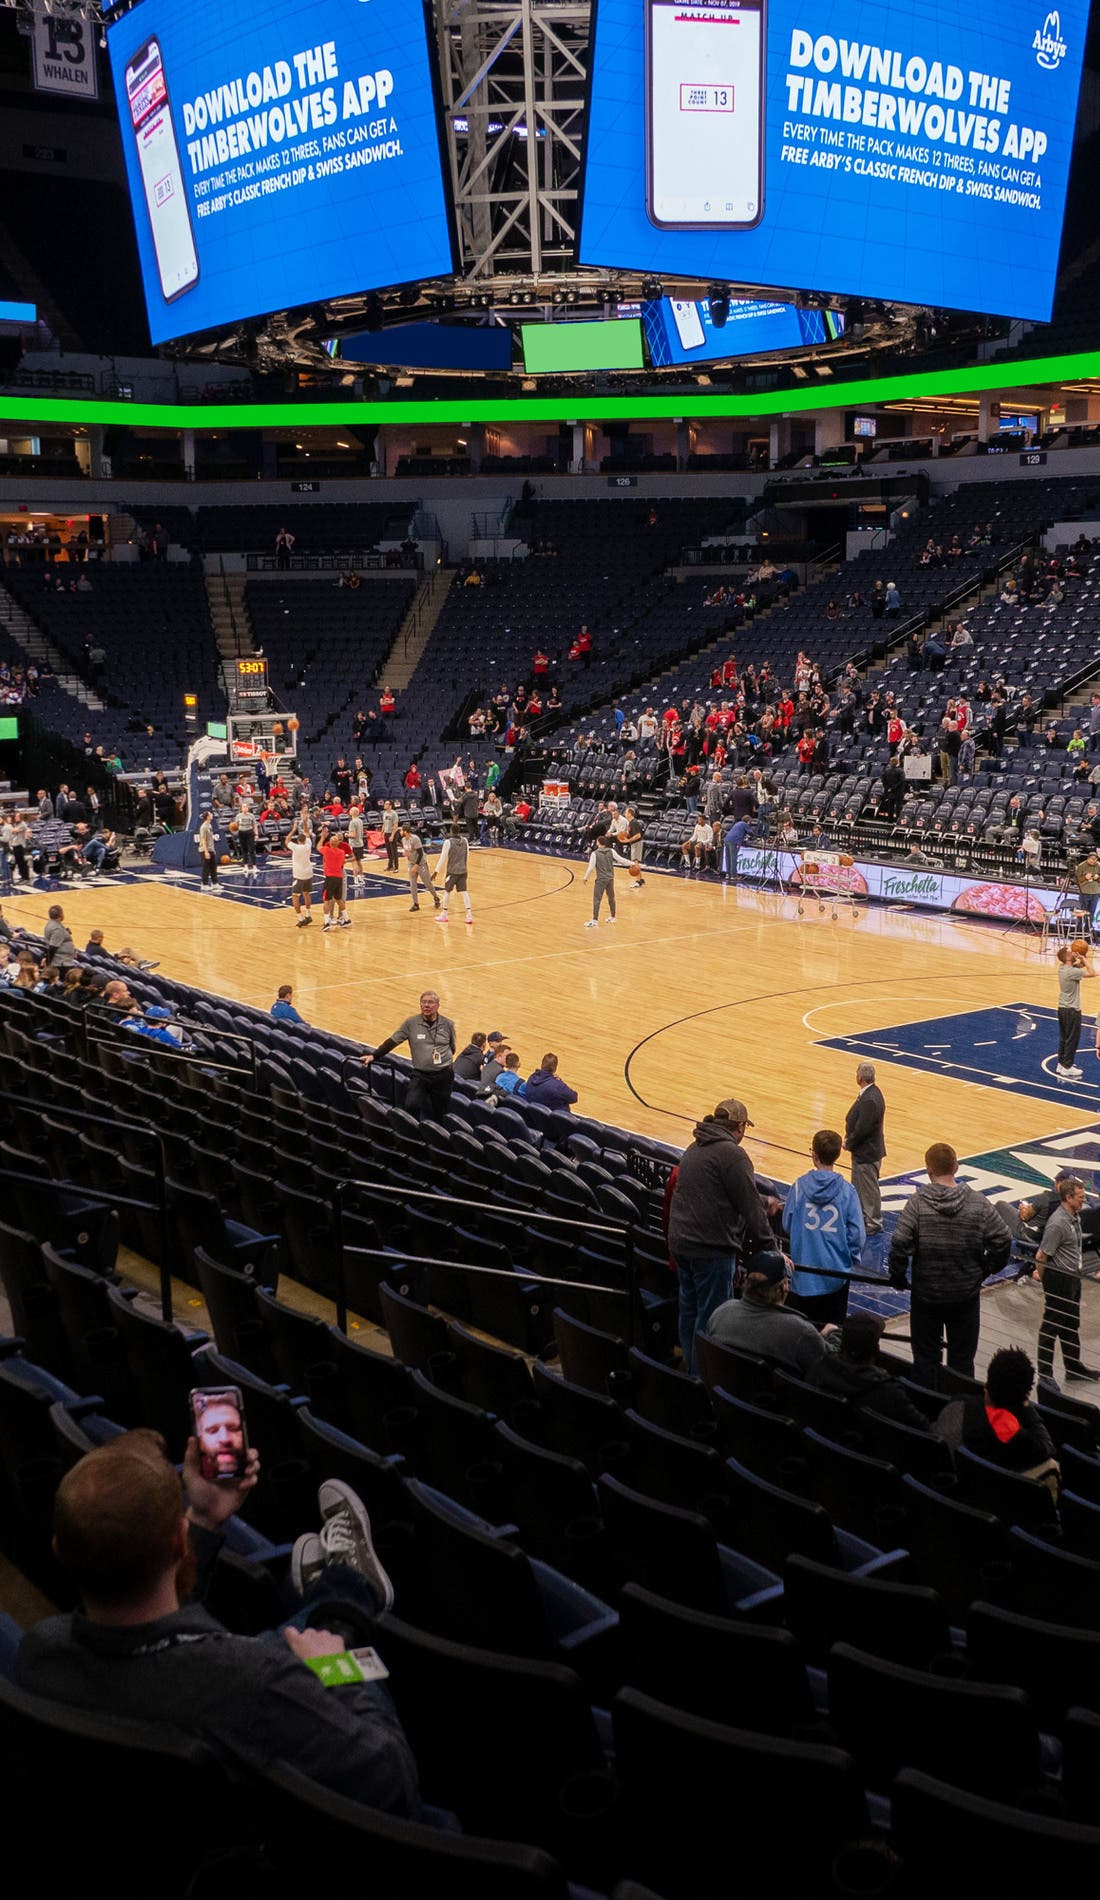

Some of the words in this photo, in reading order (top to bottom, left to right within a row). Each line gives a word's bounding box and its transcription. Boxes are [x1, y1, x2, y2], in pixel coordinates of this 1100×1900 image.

[1032, 30, 1067, 60] Arby's
[43, 63, 89, 84] WHALEN
[182, 60, 292, 136] DOWNLOAD
[292, 40, 339, 90] THE
[789, 28, 964, 102] DOWNLOAD
[968, 70, 1012, 115] THE
[187, 87, 338, 174] TIMBERWOLVES
[342, 69, 394, 120] APP
[714, 91, 728, 106] 13
[785, 73, 1001, 154] TIMBERWOLVES
[1002, 124, 1048, 164] APP
[193, 177, 212, 198] EVERY
[212, 173, 225, 192] TIME
[224, 169, 237, 186] THE
[237, 162, 255, 182] PACK
[255, 152, 280, 175] MAKES
[281, 149, 290, 166] 12
[291, 140, 321, 163] THREES,
[322, 131, 346, 153] FANS
[346, 123, 368, 146] CAN
[369, 118, 387, 139] GET
[389, 115, 398, 132] A
[780, 145, 809, 165] FREE
[809, 150, 852, 173] ARBY'S
[853, 157, 897, 181] CLASSIC
[897, 166, 938, 188] FRENCH
[938, 174, 956, 191] DIP
[956, 178, 964, 194] &
[965, 180, 993, 200] SWISS
[993, 186, 1041, 210] SANDWICH.
[783, 121, 818, 142] EVERY
[819, 127, 846, 148] TIME
[847, 133, 866, 152] THE
[867, 137, 894, 157] PACK
[895, 144, 929, 164] MAKES
[932, 149, 941, 167] 12
[943, 152, 976, 176] THREES,
[977, 160, 1000, 180] FANS
[1000, 165, 1020, 184] CAN
[1020, 170, 1036, 187] GET
[1035, 174, 1042, 189] A
[196, 200, 211, 219] FREE
[210, 191, 233, 215] ARBY'S
[233, 183, 261, 206] CLASSIC
[261, 171, 292, 196] FRENCH
[292, 169, 307, 186] DIP
[307, 164, 316, 181] &
[316, 155, 343, 179] SWISS
[344, 139, 404, 170] SANDWICH.
[1027, 455, 1040, 464] 129
[299, 483, 312, 491] 124
[239, 662, 264, 673] 53:07
[883, 874, 940, 895] Freschetta
[804, 1203, 839, 1232] 32
